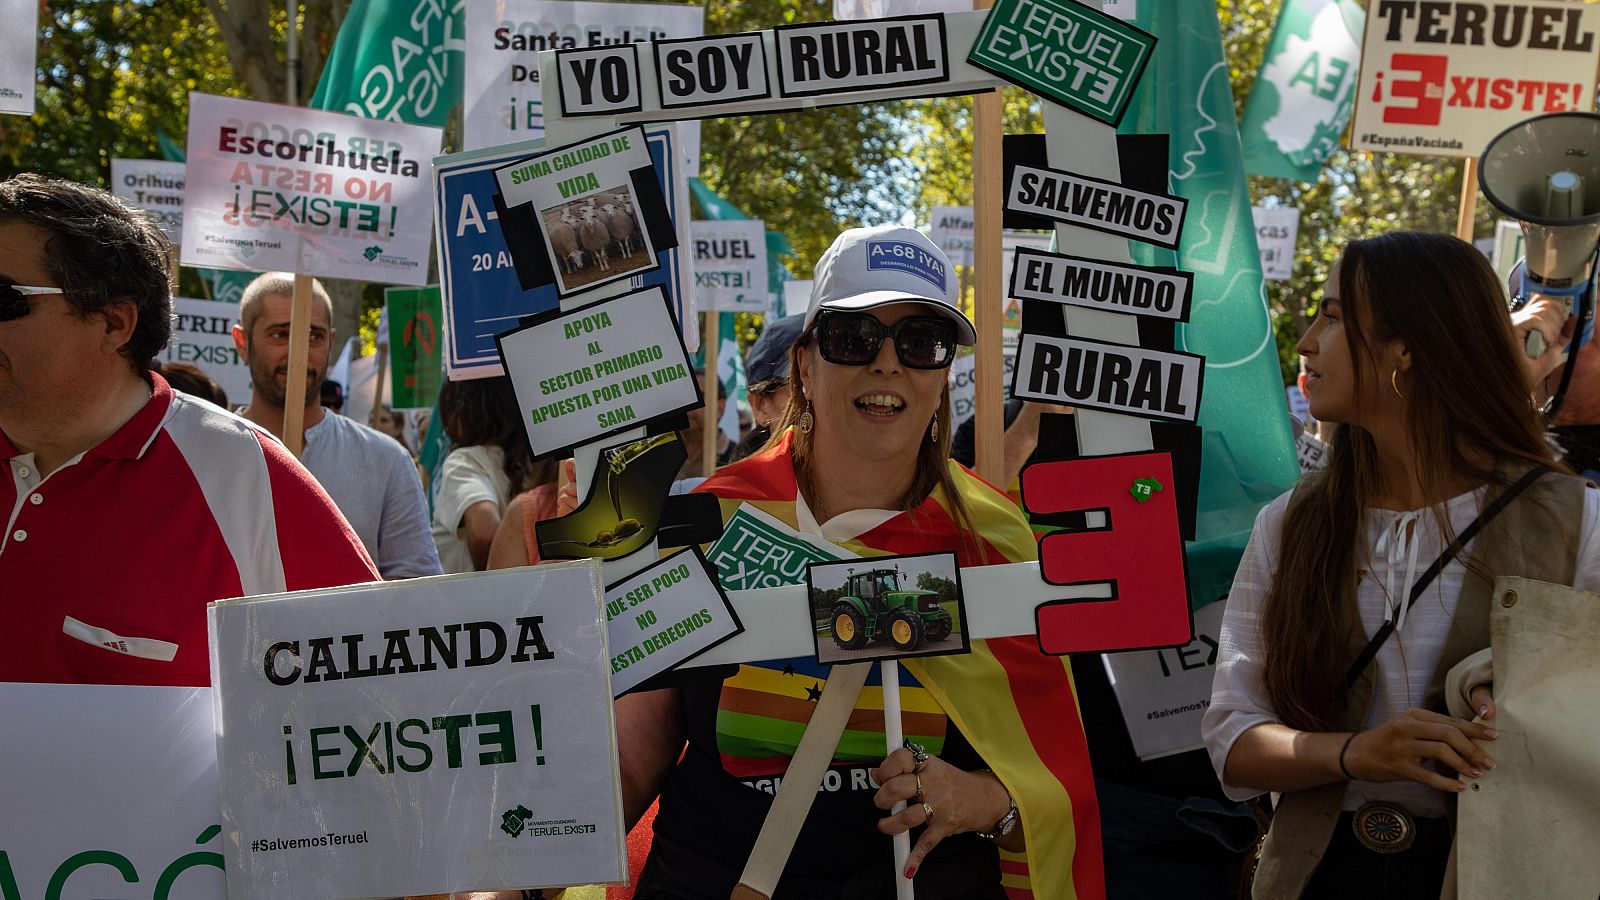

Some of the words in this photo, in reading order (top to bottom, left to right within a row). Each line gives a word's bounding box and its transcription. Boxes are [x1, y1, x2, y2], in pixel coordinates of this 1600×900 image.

[494, 28, 576, 51] Santa
[1009, 0, 1123, 73] TERUEL
[1378, 0, 1594, 52] TERUEL
[569, 56, 629, 105] YO
[667, 43, 753, 96] SOY
[790, 24, 936, 82] RURAL
[218, 126, 419, 178] Escorihuela
[1361, 133, 1463, 150] #EspañaVaciada
[511, 164, 552, 185] SUMA
[553, 142, 611, 172] CALIDAD
[612, 136, 631, 152] DE
[124, 174, 185, 189] Orihue
[557, 172, 600, 199] VIDA
[134, 191, 184, 206] Trem
[1017, 172, 1175, 236] SALVEMOS
[472, 254, 492, 272] 20
[694, 239, 756, 259] RUEL
[871, 244, 916, 260] A-68
[918, 250, 945, 277] ¡YA!
[1023, 260, 1054, 294] EL
[1062, 265, 1176, 313] MUNDO
[563, 311, 613, 340] APOYA
[587, 341, 603, 356] AL
[539, 367, 594, 396] SECTOR
[593, 345, 663, 379] PRIMARIO
[1028, 342, 1187, 416] RURAL
[531, 392, 593, 425] APUESTA
[592, 386, 622, 405] POR
[622, 374, 653, 395] UNA
[651, 363, 688, 387] VIDA
[597, 405, 637, 429] SANA
[625, 583, 654, 607] SER
[651, 563, 690, 593] POCO
[635, 609, 658, 631] NO
[263, 615, 555, 686] CALANDA
[610, 645, 646, 675] ESTA
[641, 608, 713, 655] DERECHOS
[252, 830, 369, 852] #SalvemosTeruel
[528, 826, 563, 837] TERUEL
